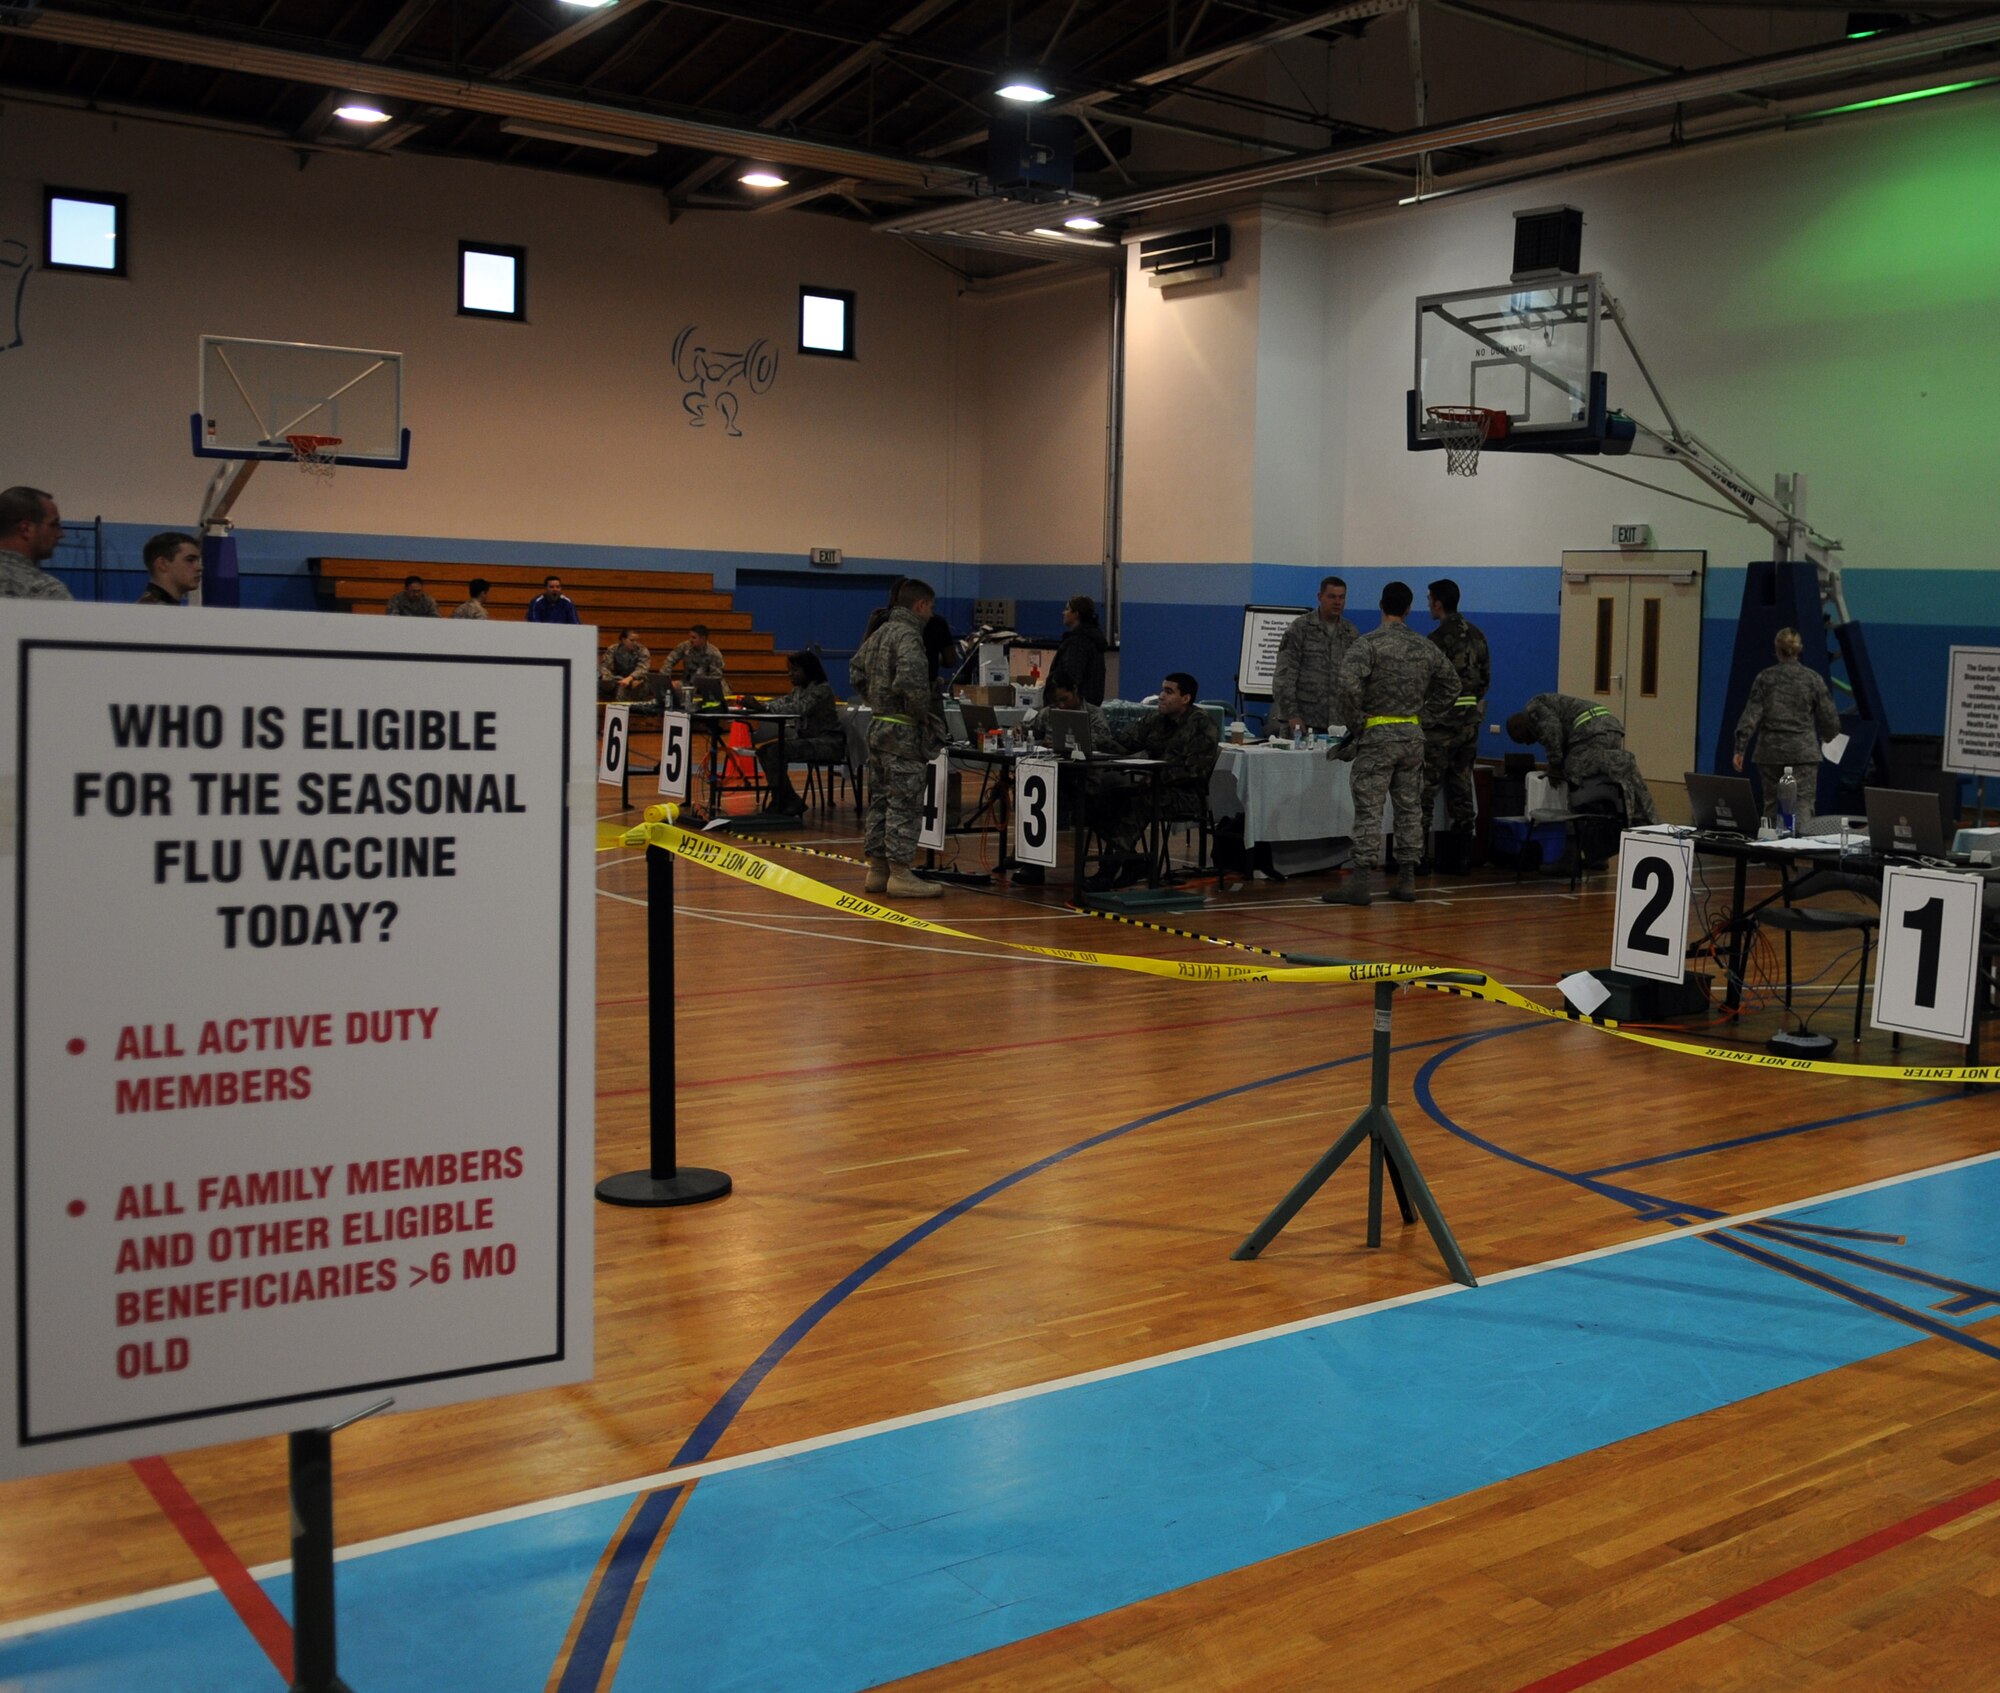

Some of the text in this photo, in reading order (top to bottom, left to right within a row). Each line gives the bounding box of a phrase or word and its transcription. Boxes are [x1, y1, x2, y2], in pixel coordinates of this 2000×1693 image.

[1475, 348, 1486, 357] NO
[819, 550, 836, 562] EXIT
[1618, 527, 1637, 542] EXIT
[109, 703, 497, 752] WHO IS ELIGIBLE
[605, 717, 623, 773] 6
[664, 725, 684, 783] 5
[74, 771, 526, 818] FOR THE SEASONAL
[1022, 777, 1048, 848] 3
[153, 836, 457, 884] FLU VACCINE
[677, 834, 769, 880] DO NOT ENTER
[218, 900, 399, 950] TODAY?
[835, 894, 880, 916] ENTER
[878, 910, 908, 924] NOT
[1627, 856, 1675, 956] 2
[1349, 964, 1393, 981] ENTER
[1903, 897, 1945, 1009] 1
[114, 1006, 440, 1061] ALL ACTIVE DUTY
[1705, 1047, 1812, 1069] DO NOT ENTER
[1903, 1068, 1953, 1078] ENTER
[1958, 1068, 1989, 1079] NOT
[115, 1065, 312, 1116] MEMBERS
[114, 1145, 525, 1221] ALL FAMILY MEMBERS
[114, 1197, 494, 1275] AND OTHER ELIGIBLE
[115, 1241, 517, 1327] BENEFICIARIES >6 MO
[115, 1337, 190, 1380] OLD
